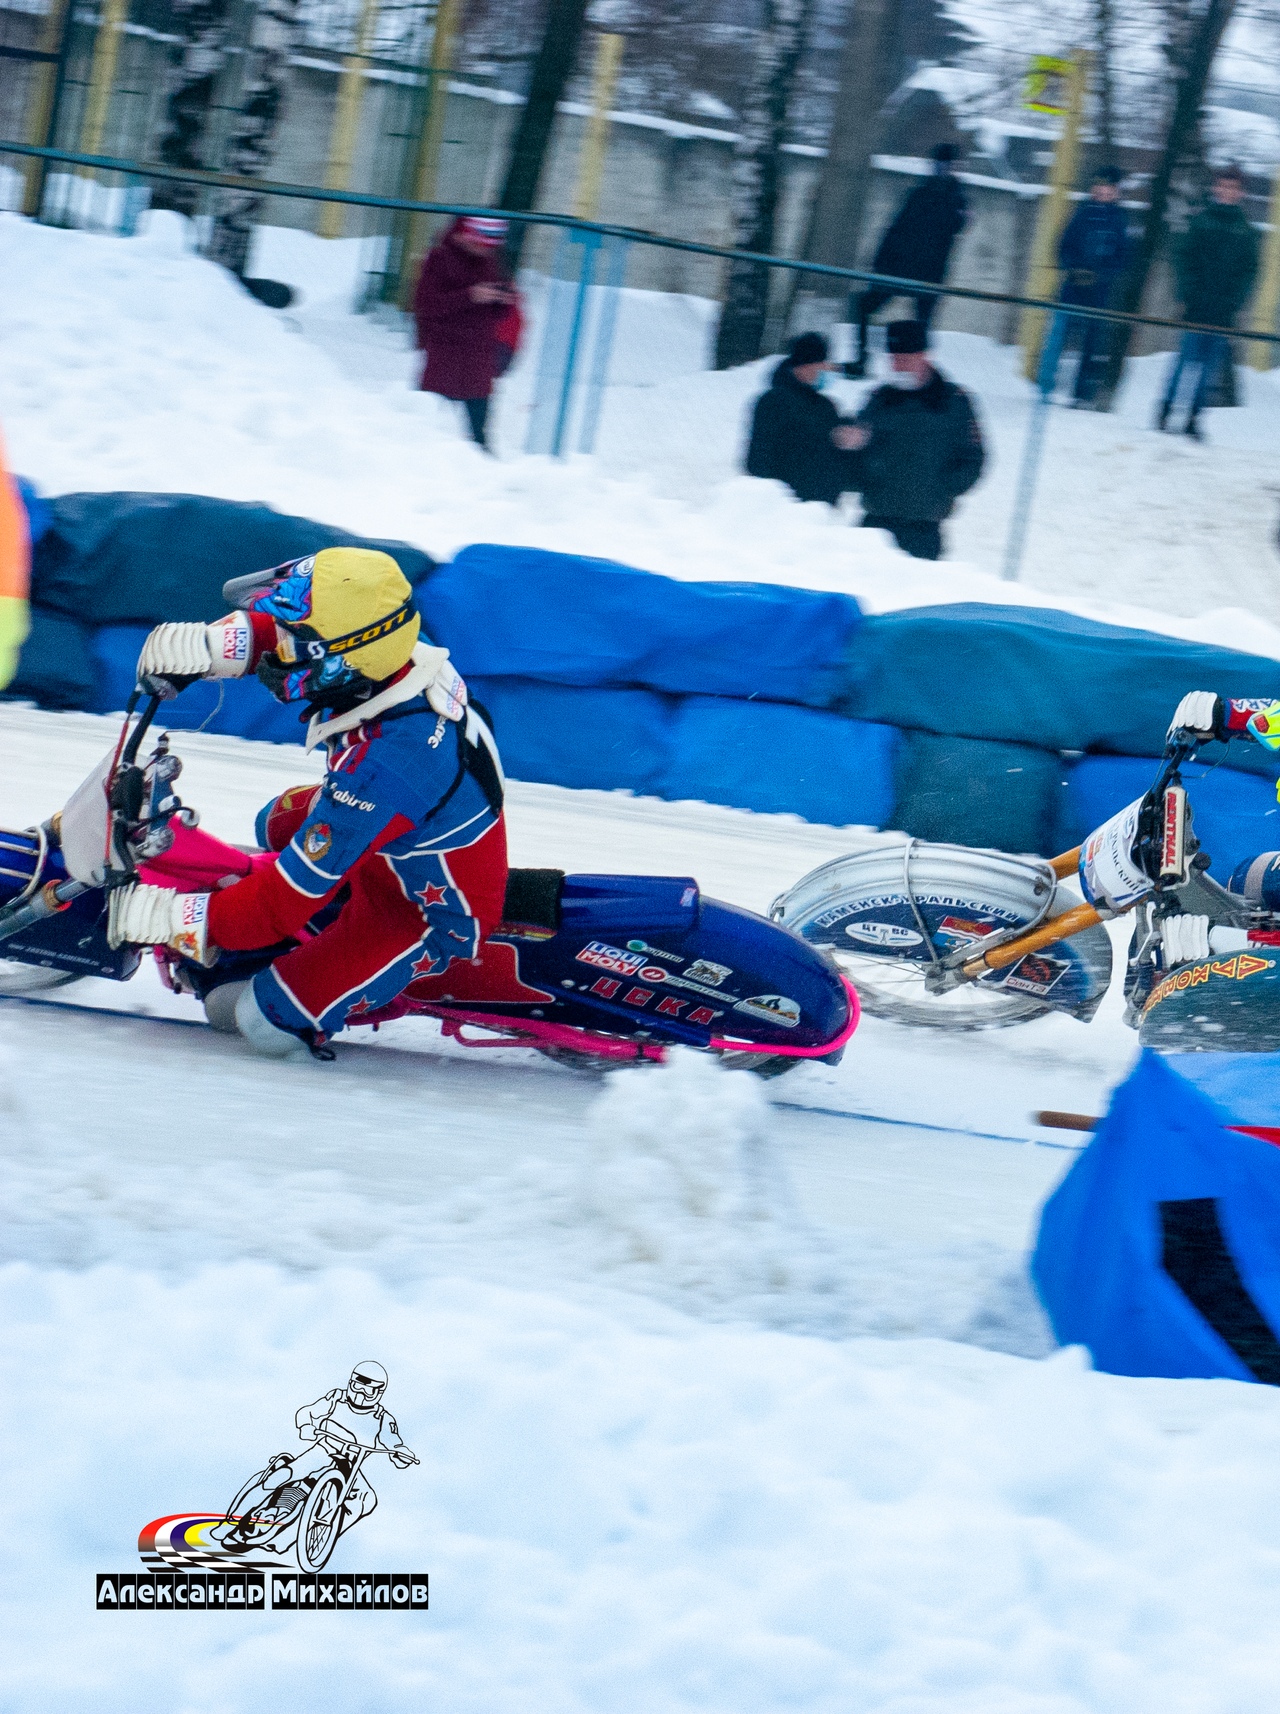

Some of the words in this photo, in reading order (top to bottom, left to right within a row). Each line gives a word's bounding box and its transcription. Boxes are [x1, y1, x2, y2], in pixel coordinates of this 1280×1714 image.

[224, 628, 236, 660] MOLY
[236, 628, 247, 660] LIQUI
[328, 608, 408, 653] SCOTT
[1231, 698, 1273, 713] ARA
[1165, 792, 1177, 868] RENTHAL
[183, 896, 196, 926] MOLY
[194, 895, 207, 924] LIQUI
[582, 952, 638, 975] MOLY
[589, 942, 647, 966] LIQUI
[590, 976, 717, 1026] ЦСКА
